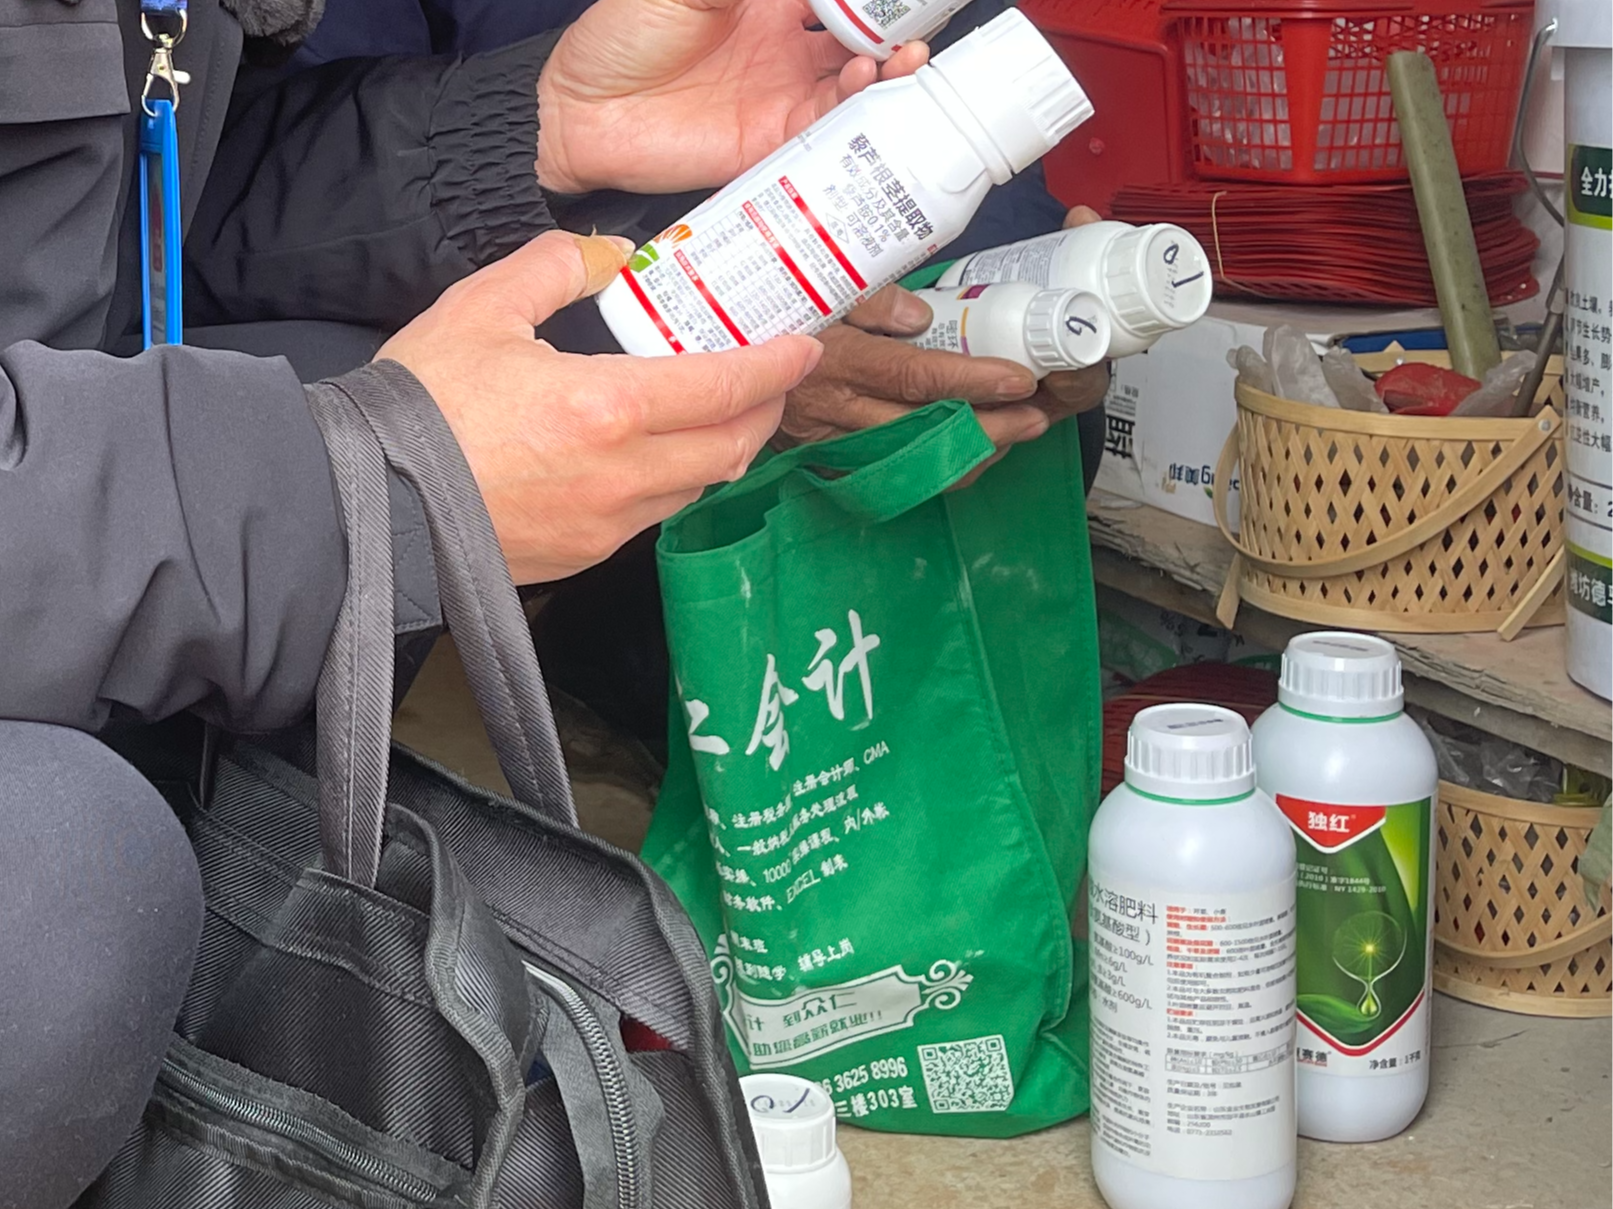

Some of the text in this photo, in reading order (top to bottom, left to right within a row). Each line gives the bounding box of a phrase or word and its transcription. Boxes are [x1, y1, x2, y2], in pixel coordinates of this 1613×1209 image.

[1581, 166, 1613, 198] 全力
[1307, 811, 1350, 833] 独红
[836, 1067, 869, 1094] 3625
[870, 1056, 908, 1081] 8996
